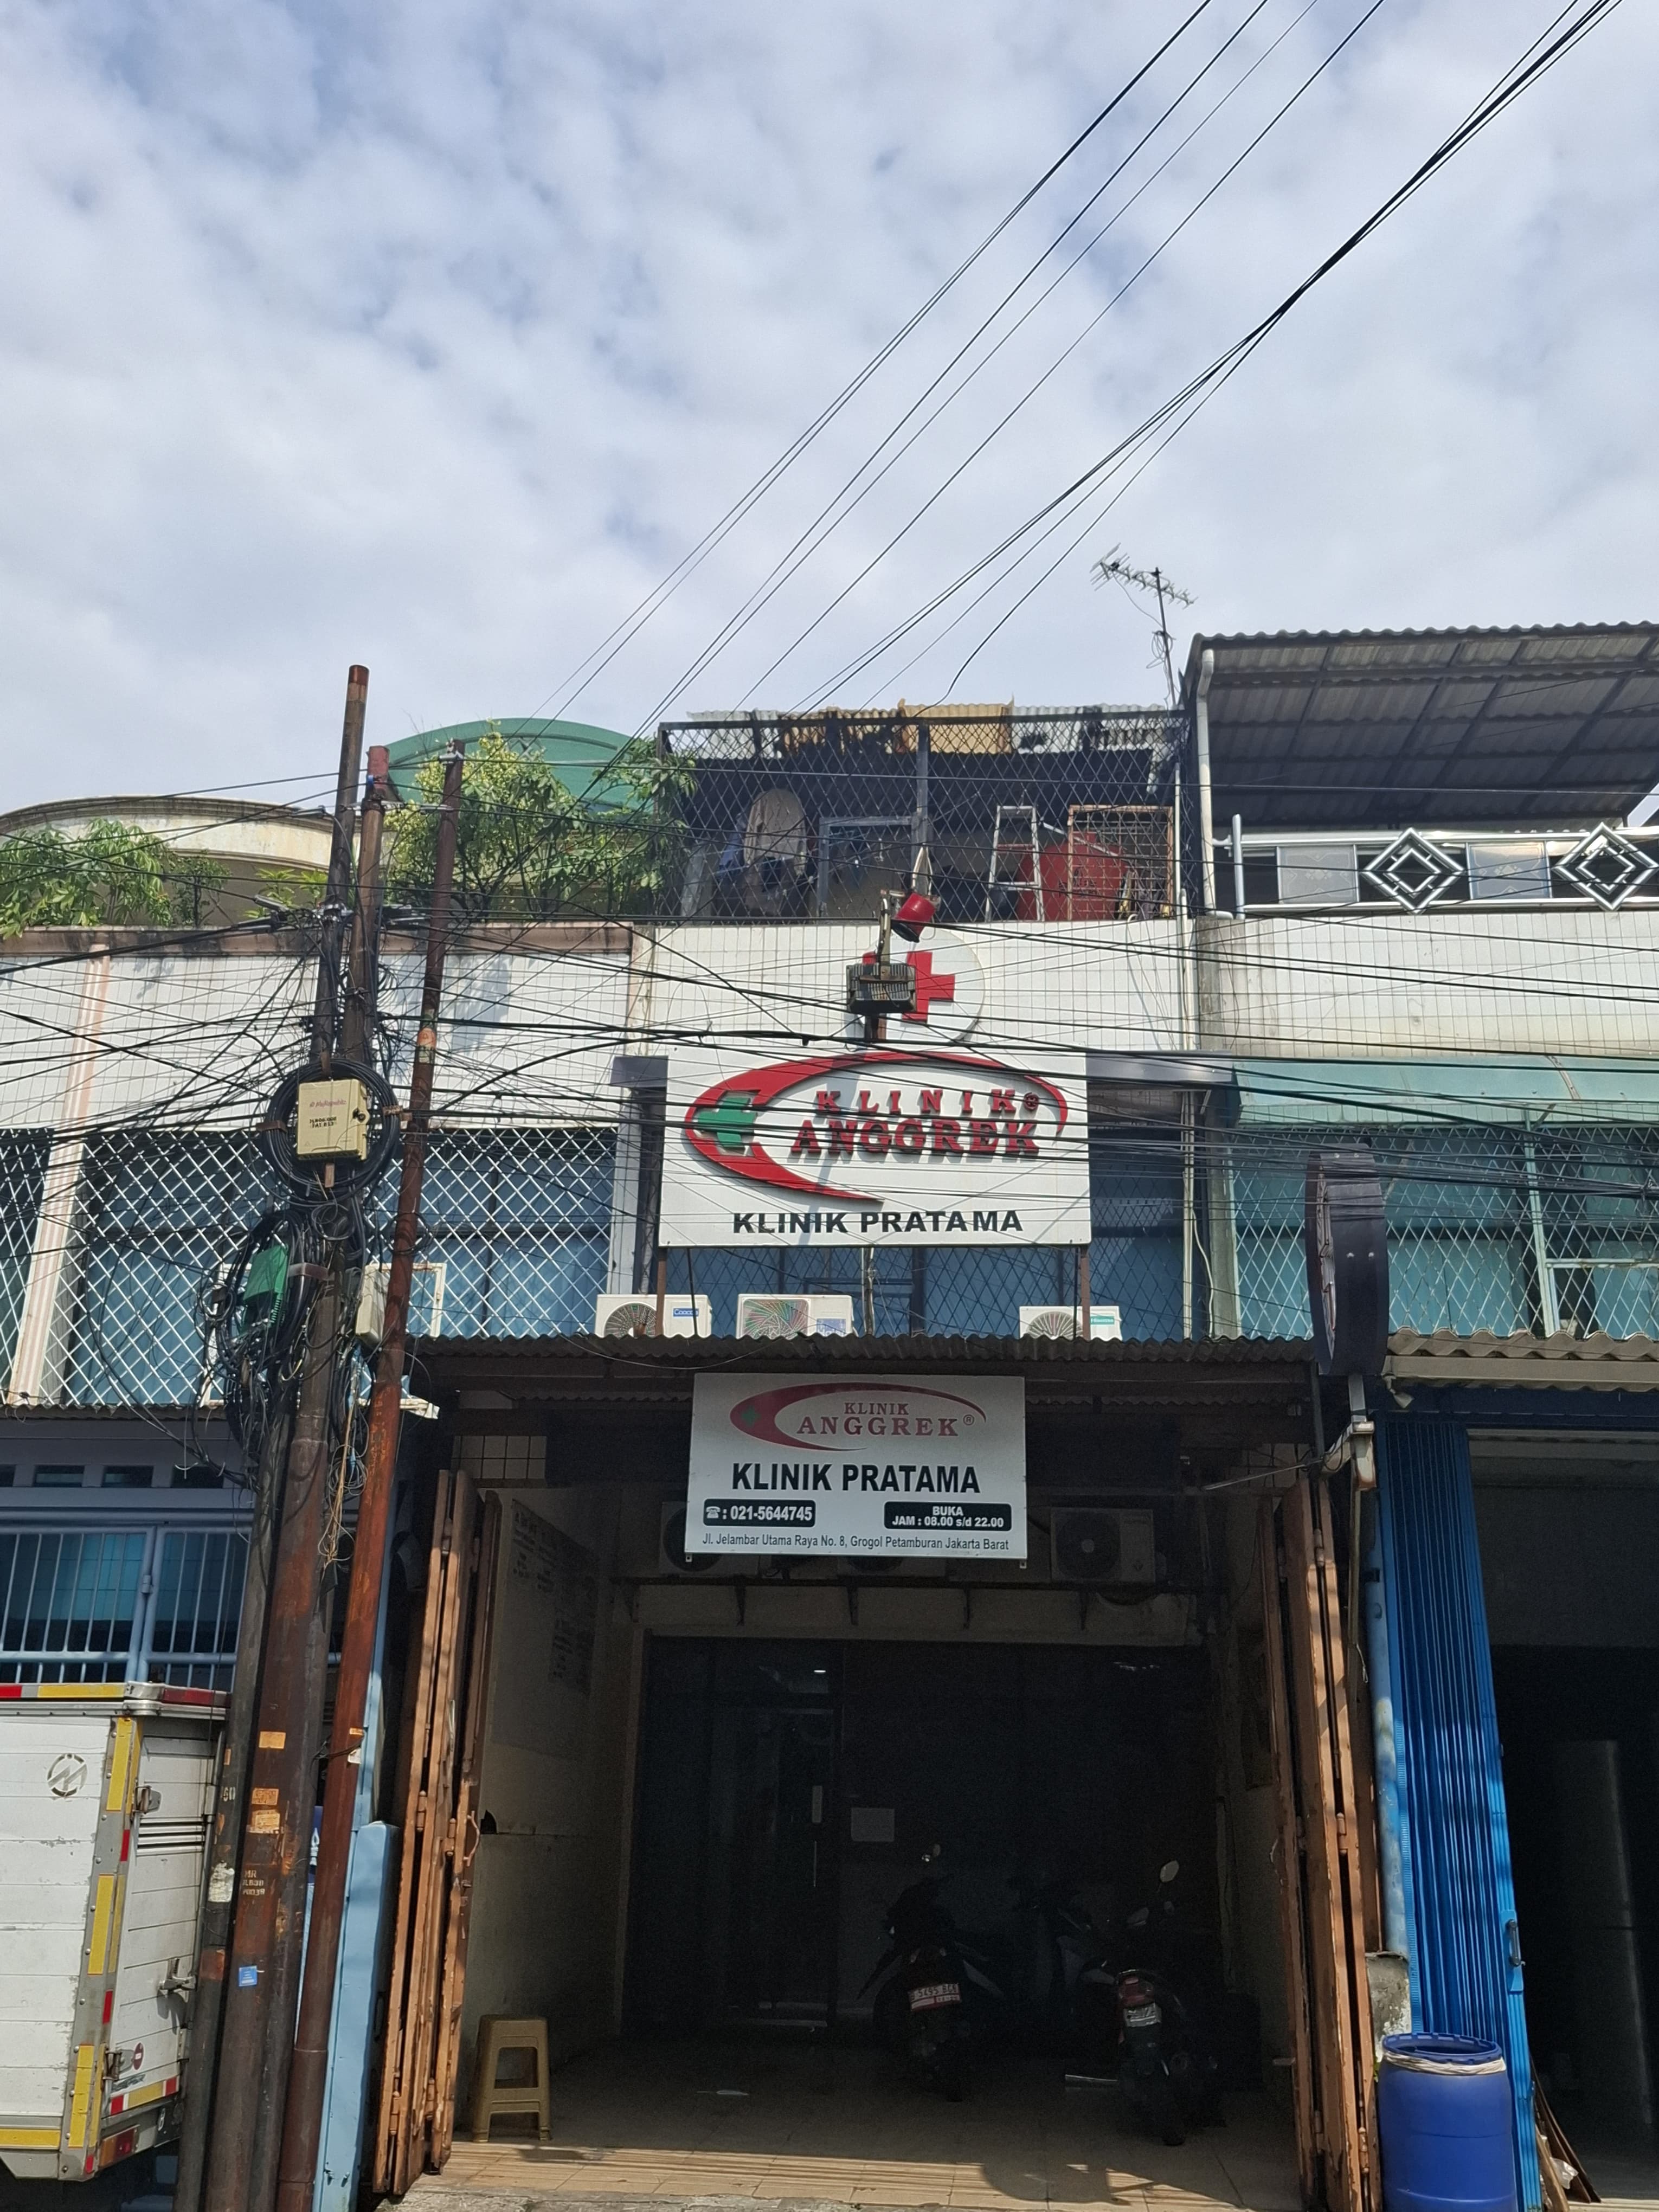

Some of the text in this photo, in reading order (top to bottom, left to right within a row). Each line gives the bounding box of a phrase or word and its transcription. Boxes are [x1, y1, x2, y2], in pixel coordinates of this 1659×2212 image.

[816, 1089, 1016, 1113] KLINIK
[790, 1118, 1039, 1154] ANGGREK
[733, 1210, 1023, 1233] KLINIK PRATAMA
[844, 1403, 909, 1415] KLINIK
[796, 1417, 959, 1436] ANGGREK
[732, 1463, 980, 1493] KLINIK PRATAMA
[730, 1506, 813, 1521] 021-5644745
[933, 1506, 963, 1516] BUKA
[892, 1515, 915, 1526] JAM
[924, 1516, 953, 1527] 08.00
[956, 1517, 972, 1527] s/d
[974, 1517, 1004, 1527] 22.00
[703, 1533, 1009, 1550] Jl. Jelambar Utama Raya No. 8, Grogol Petamburan Jakarta Barat
